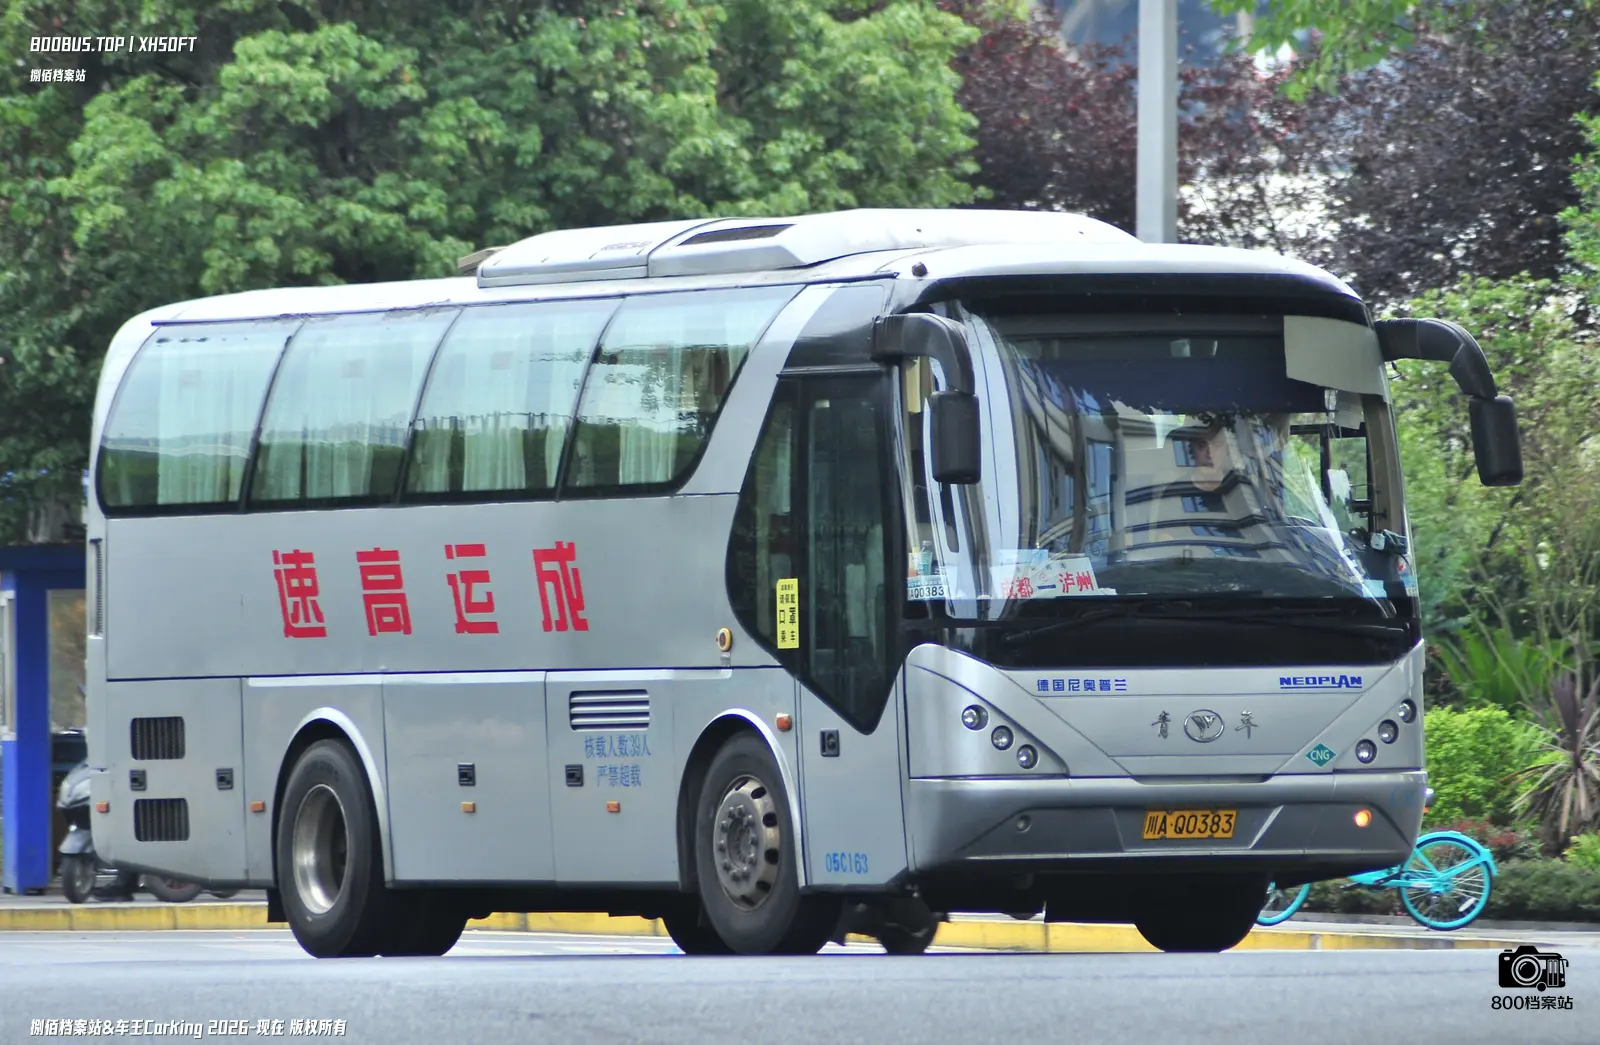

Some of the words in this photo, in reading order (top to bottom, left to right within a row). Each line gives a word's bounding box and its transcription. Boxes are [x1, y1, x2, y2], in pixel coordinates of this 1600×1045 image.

[1037, 679, 1127, 691] 德国尼奥普兰
[1279, 675, 1362, 689] NEOPLAN
[1310, 751, 1330, 761] CNG
[597, 764, 642, 788] 严禁超载
